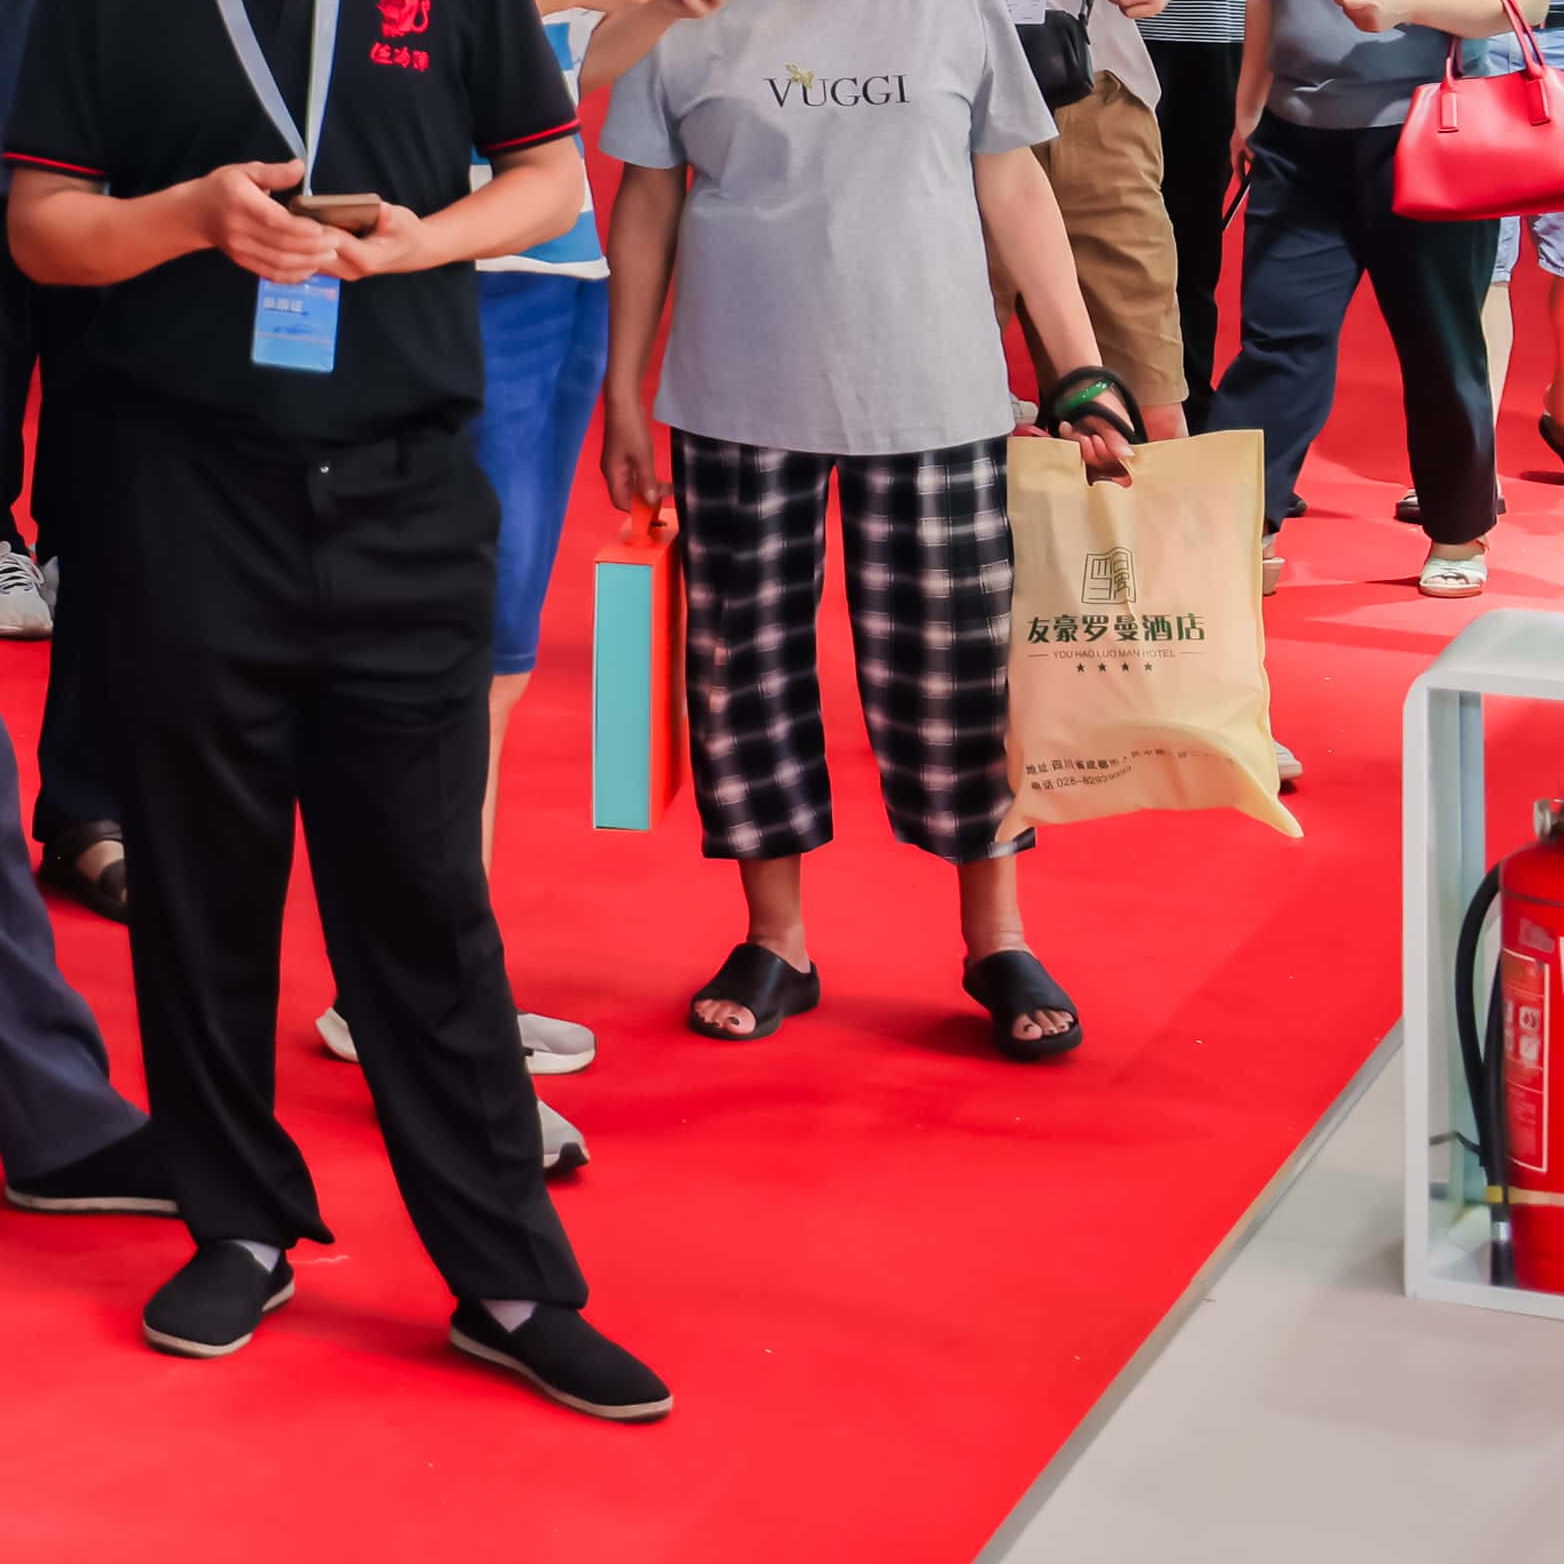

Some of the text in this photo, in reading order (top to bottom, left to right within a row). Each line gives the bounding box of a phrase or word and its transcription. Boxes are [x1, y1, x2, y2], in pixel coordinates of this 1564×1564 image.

[1027, 612, 1206, 644] 友豪罗曼酒店
